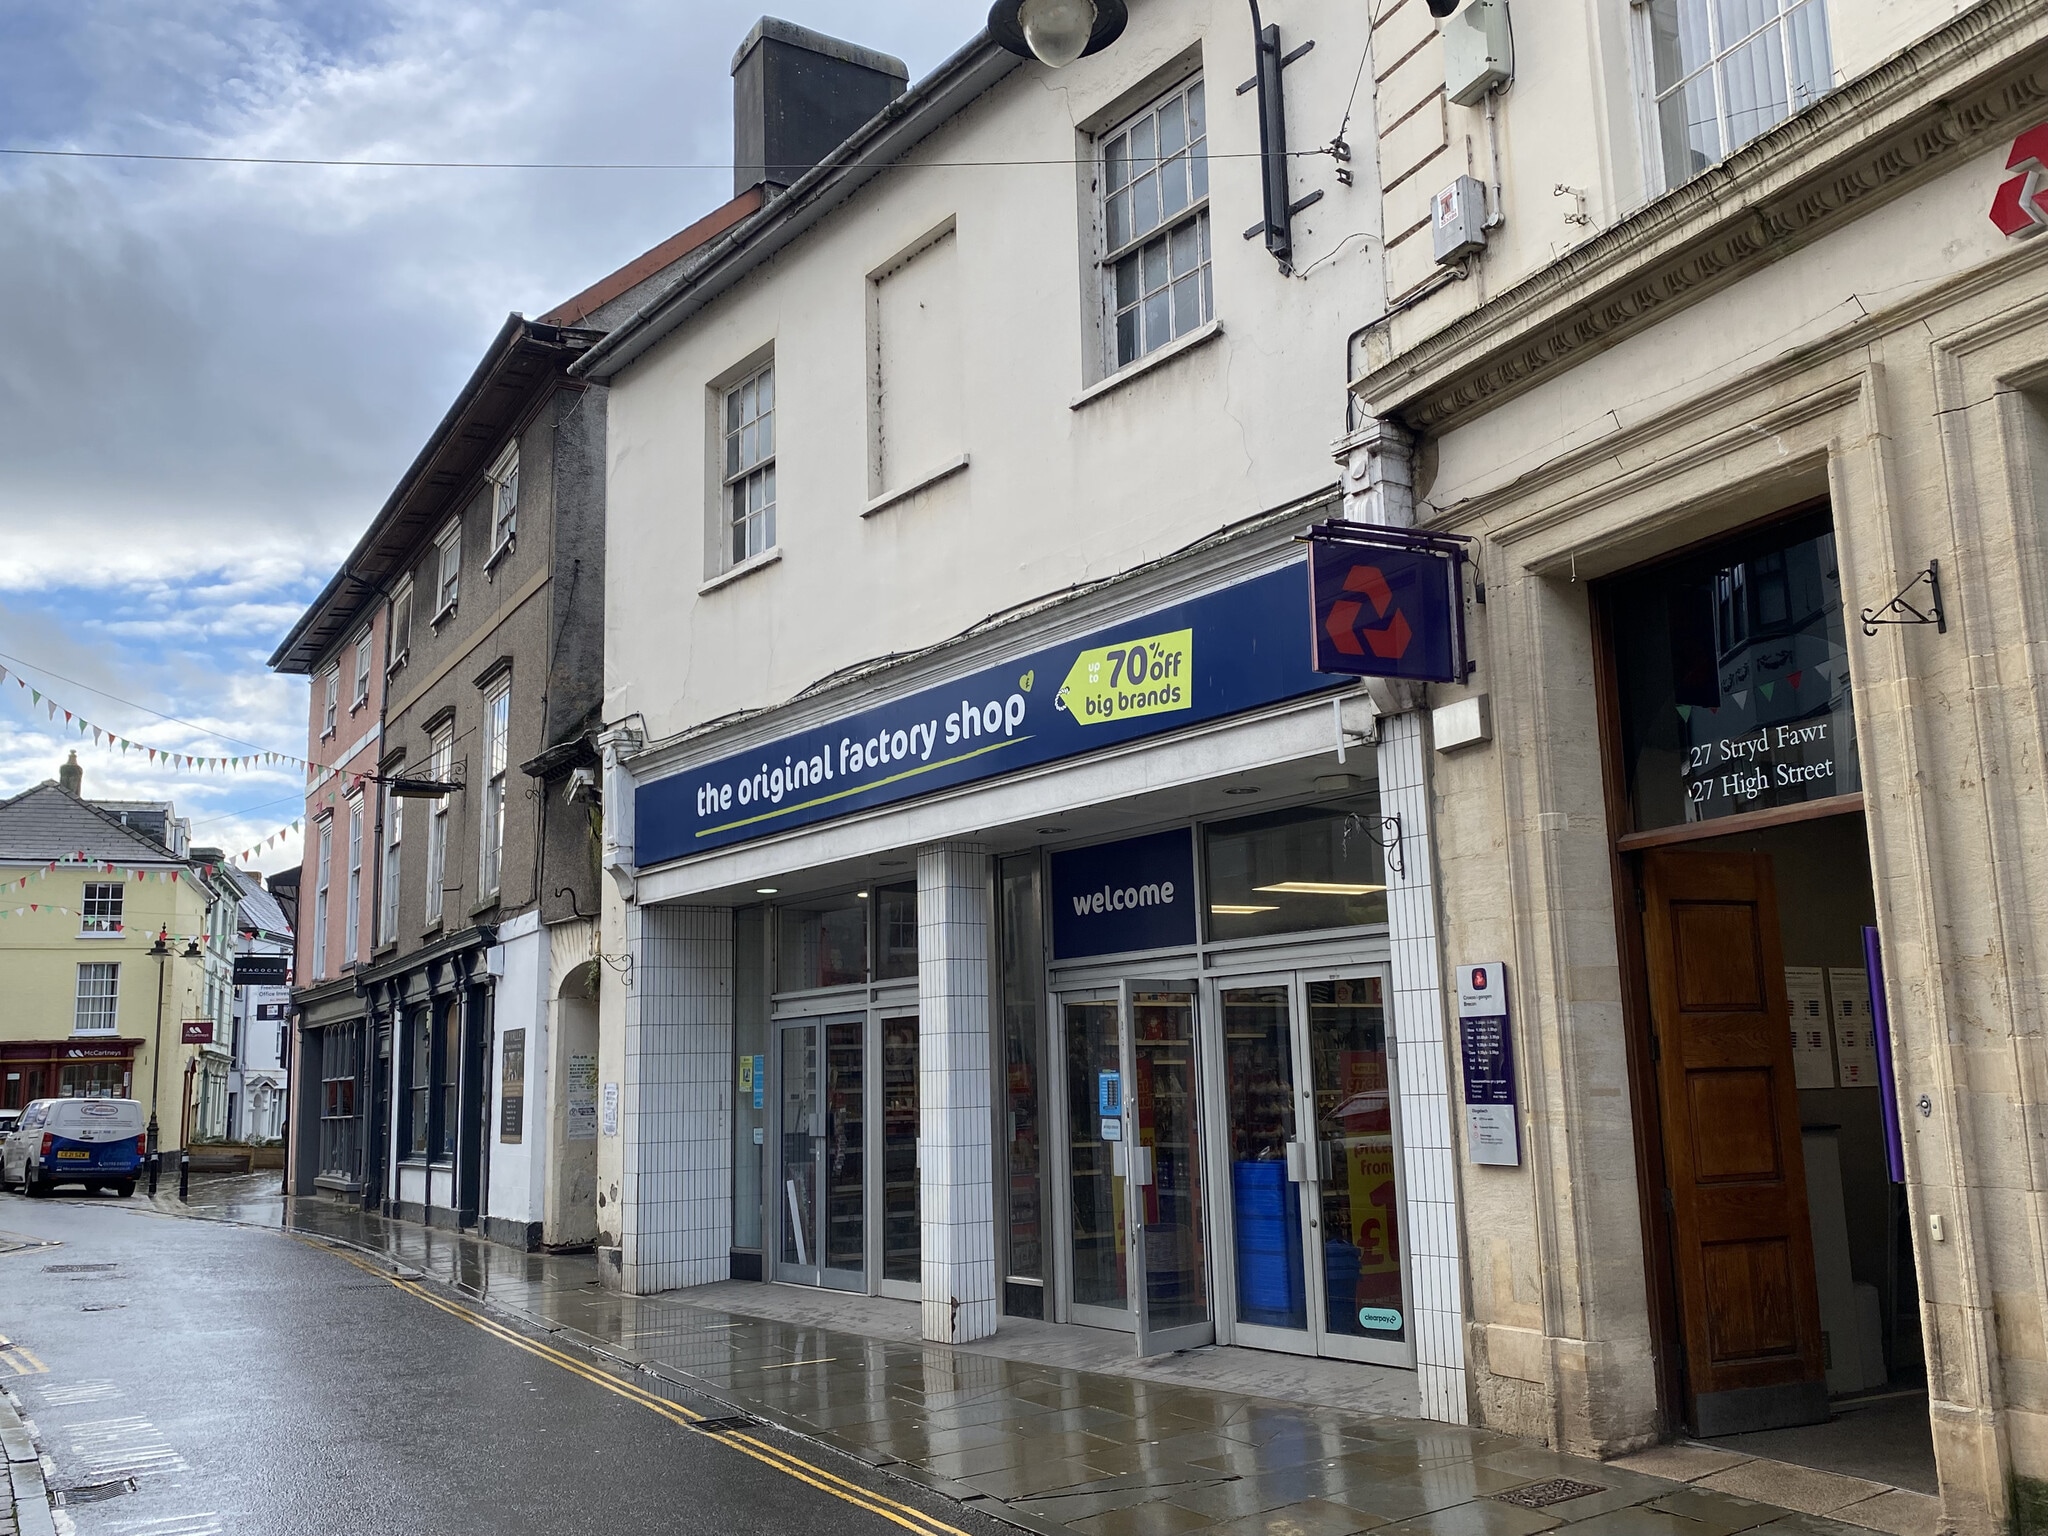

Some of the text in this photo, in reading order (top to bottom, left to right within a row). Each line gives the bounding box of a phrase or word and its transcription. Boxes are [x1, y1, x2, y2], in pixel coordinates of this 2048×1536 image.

[1088, 662, 1100, 673] up
[1150, 651, 1182, 681] off
[1089, 674, 1098, 684] to
[1086, 684, 1181, 717] big brands
[697, 693, 1026, 817] the original factory shop
[1690, 723, 1827, 768] 27 Stryd Fawr
[1692, 758, 1834, 803] 27 High Street
[1072, 881, 1175, 916] welcome
[1361, 1160, 1392, 1176] from
[1364, 1313, 1391, 1324] clearpay
